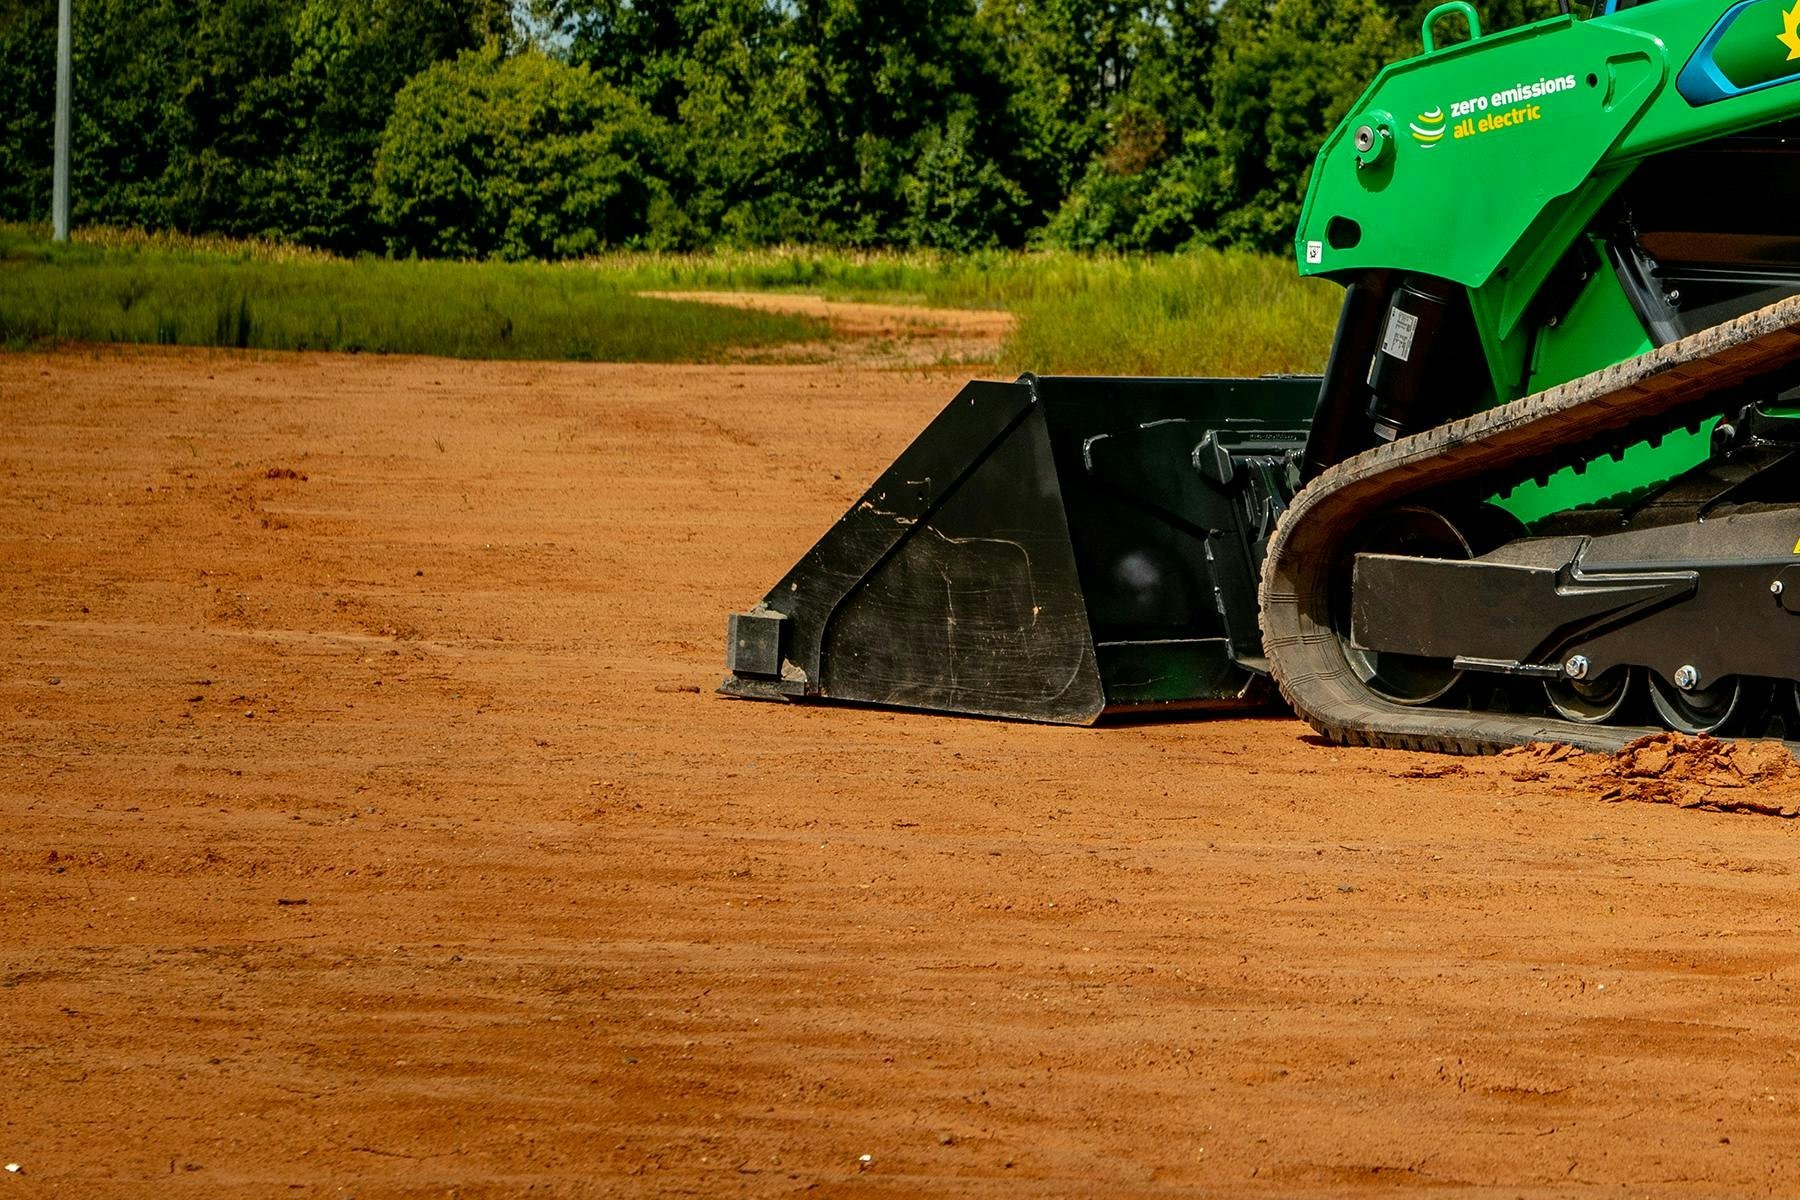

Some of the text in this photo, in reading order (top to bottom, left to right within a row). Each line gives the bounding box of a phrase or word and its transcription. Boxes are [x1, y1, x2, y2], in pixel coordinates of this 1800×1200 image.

[1450, 74, 1577, 118] zero emissions
[1453, 104, 1542, 140] all electric
